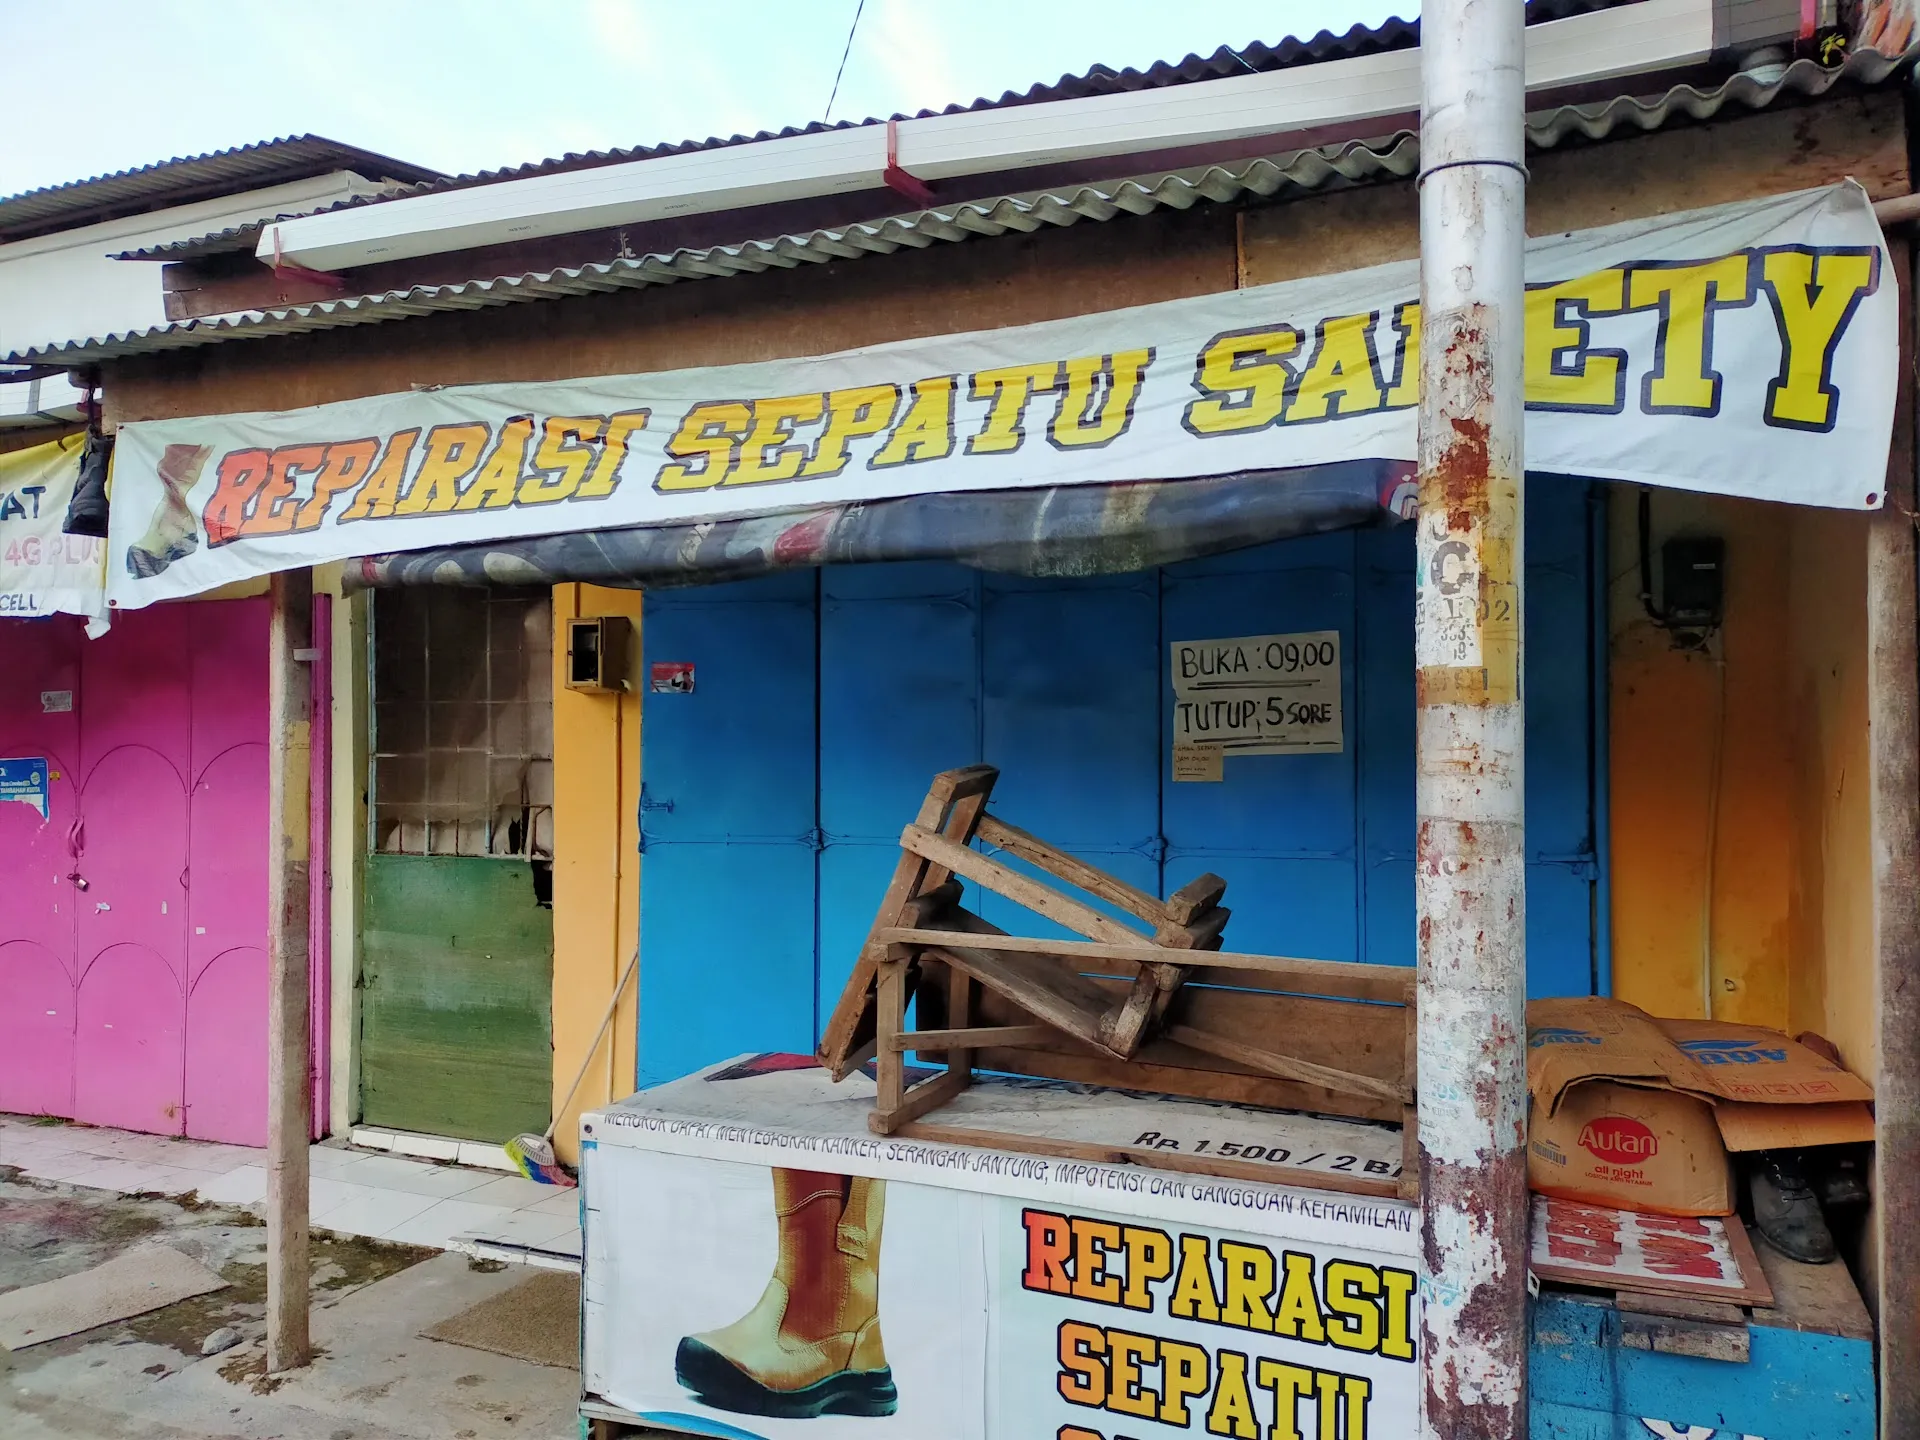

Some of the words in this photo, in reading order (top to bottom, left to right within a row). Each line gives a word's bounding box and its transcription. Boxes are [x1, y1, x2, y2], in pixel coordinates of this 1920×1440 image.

[203, 407, 652, 549] REPARASI
[651, 346, 1157, 495] SEPATU
[1181, 244, 1882, 440] SAETY
[0, 486, 46, 521] AT
[4, 537, 42, 566] 4G
[1181, 646, 1249, 678] BUKA
[1266, 697, 1284, 725] 5
[1287, 702, 1332, 725] SORE
[1577, 1124, 1658, 1157] Autan
[1330, 1155, 1353, 1172] 2
[1595, 1165, 1609, 1175] all
[1613, 1167, 1644, 1180] night
[886, 1143, 968, 1170] SERANGAN
[1054, 1163, 1145, 1193] IMPOTENSI
[1151, 1177, 1185, 1199] DAN
[1191, 1184, 1293, 1214] GANGGUAN
[1299, 1197, 1412, 1233] KEHAMILAN
[1021, 1207, 1418, 1364] REPARASI
[1056, 1319, 1373, 1440] SEPATU
